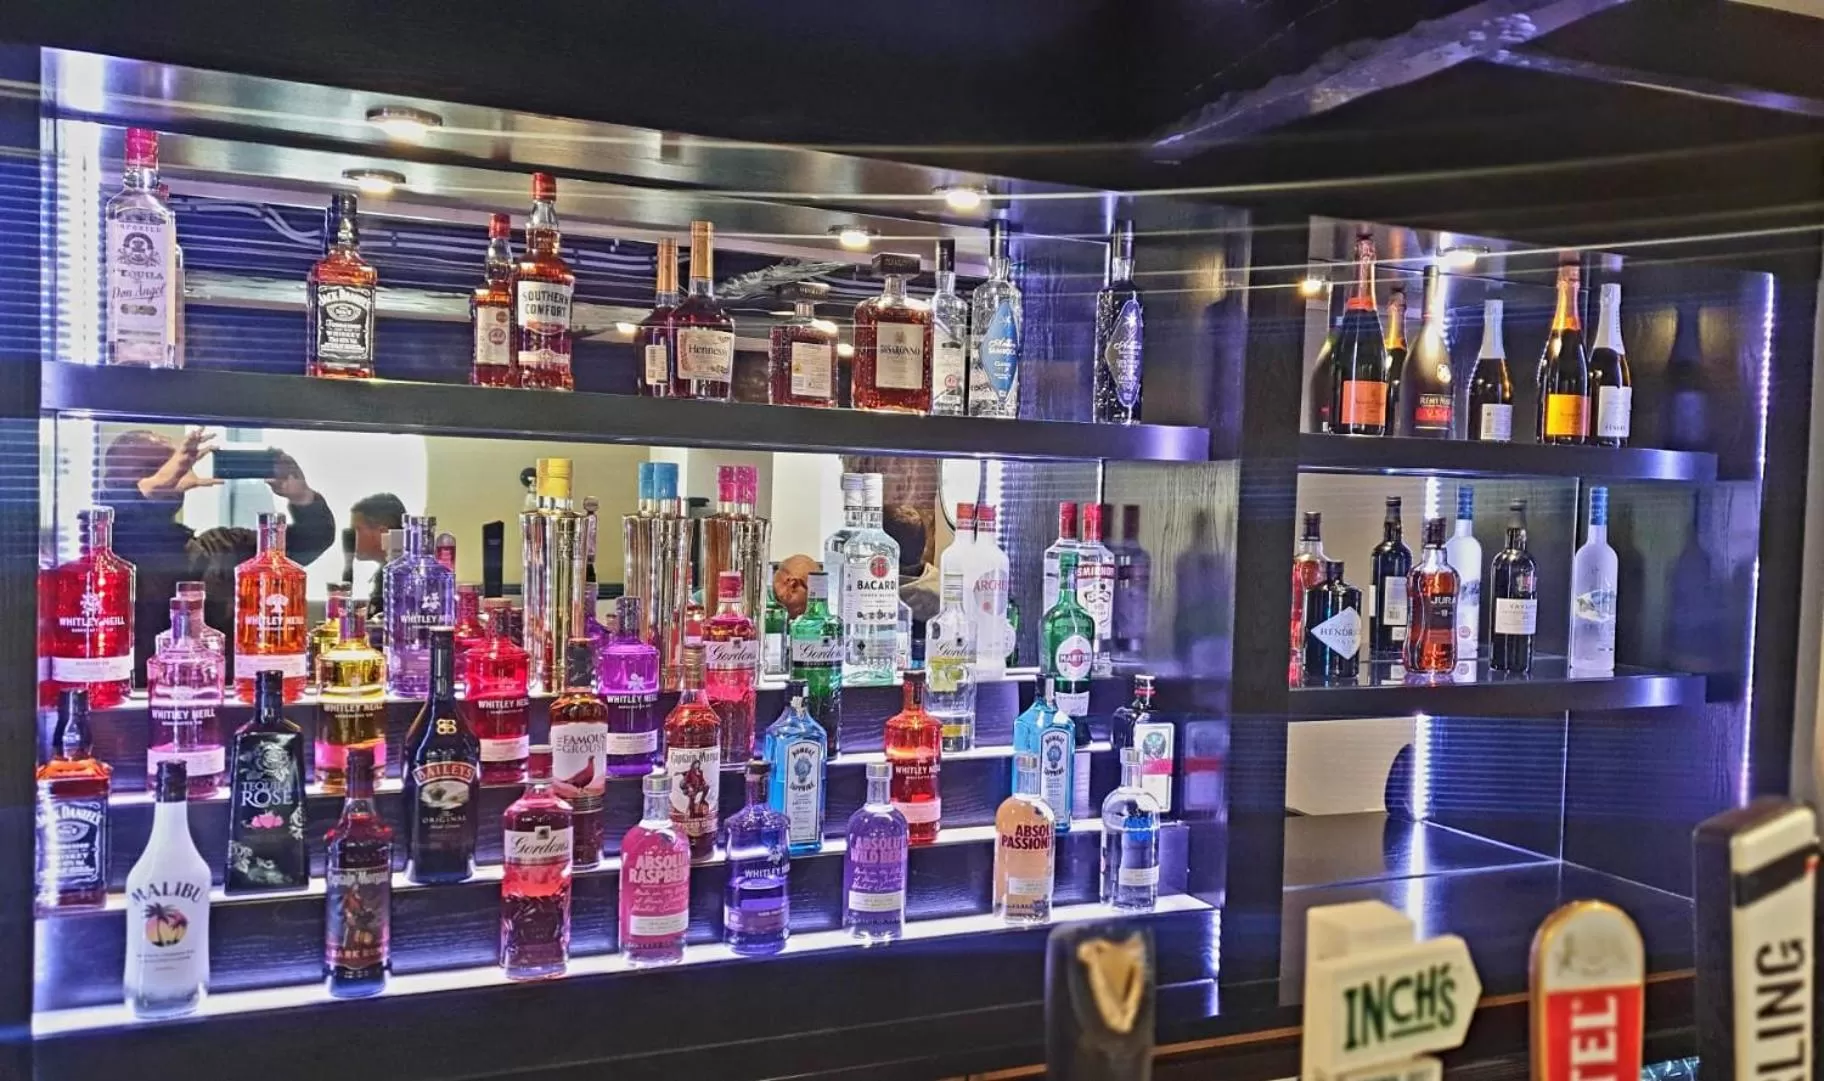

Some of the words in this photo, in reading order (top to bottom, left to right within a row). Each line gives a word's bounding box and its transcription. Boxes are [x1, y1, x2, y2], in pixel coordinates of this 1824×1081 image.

[522, 289, 569, 305] SOUTHERN
[525, 303, 567, 318] COMFORT
[59, 616, 97, 626] WHITLEY
[245, 615, 284, 625] WHITLEY
[478, 700, 515, 709] WHITLEY
[607, 695, 643, 704] WHITLEY
[323, 703, 361, 712] WHITLEY
[152, 709, 189, 720] WHITLEY
[563, 734, 606, 745] FAMOUS
[416, 763, 474, 780] BAILEYS
[894, 766, 928, 775] WHITLEY
[241, 780, 293, 792] TEQUILA
[241, 789, 293, 808] ROSE
[131, 881, 203, 905] MALIBU
[1343, 961, 1457, 1051] INCH'S
[1755, 936, 1805, 1081] LING
